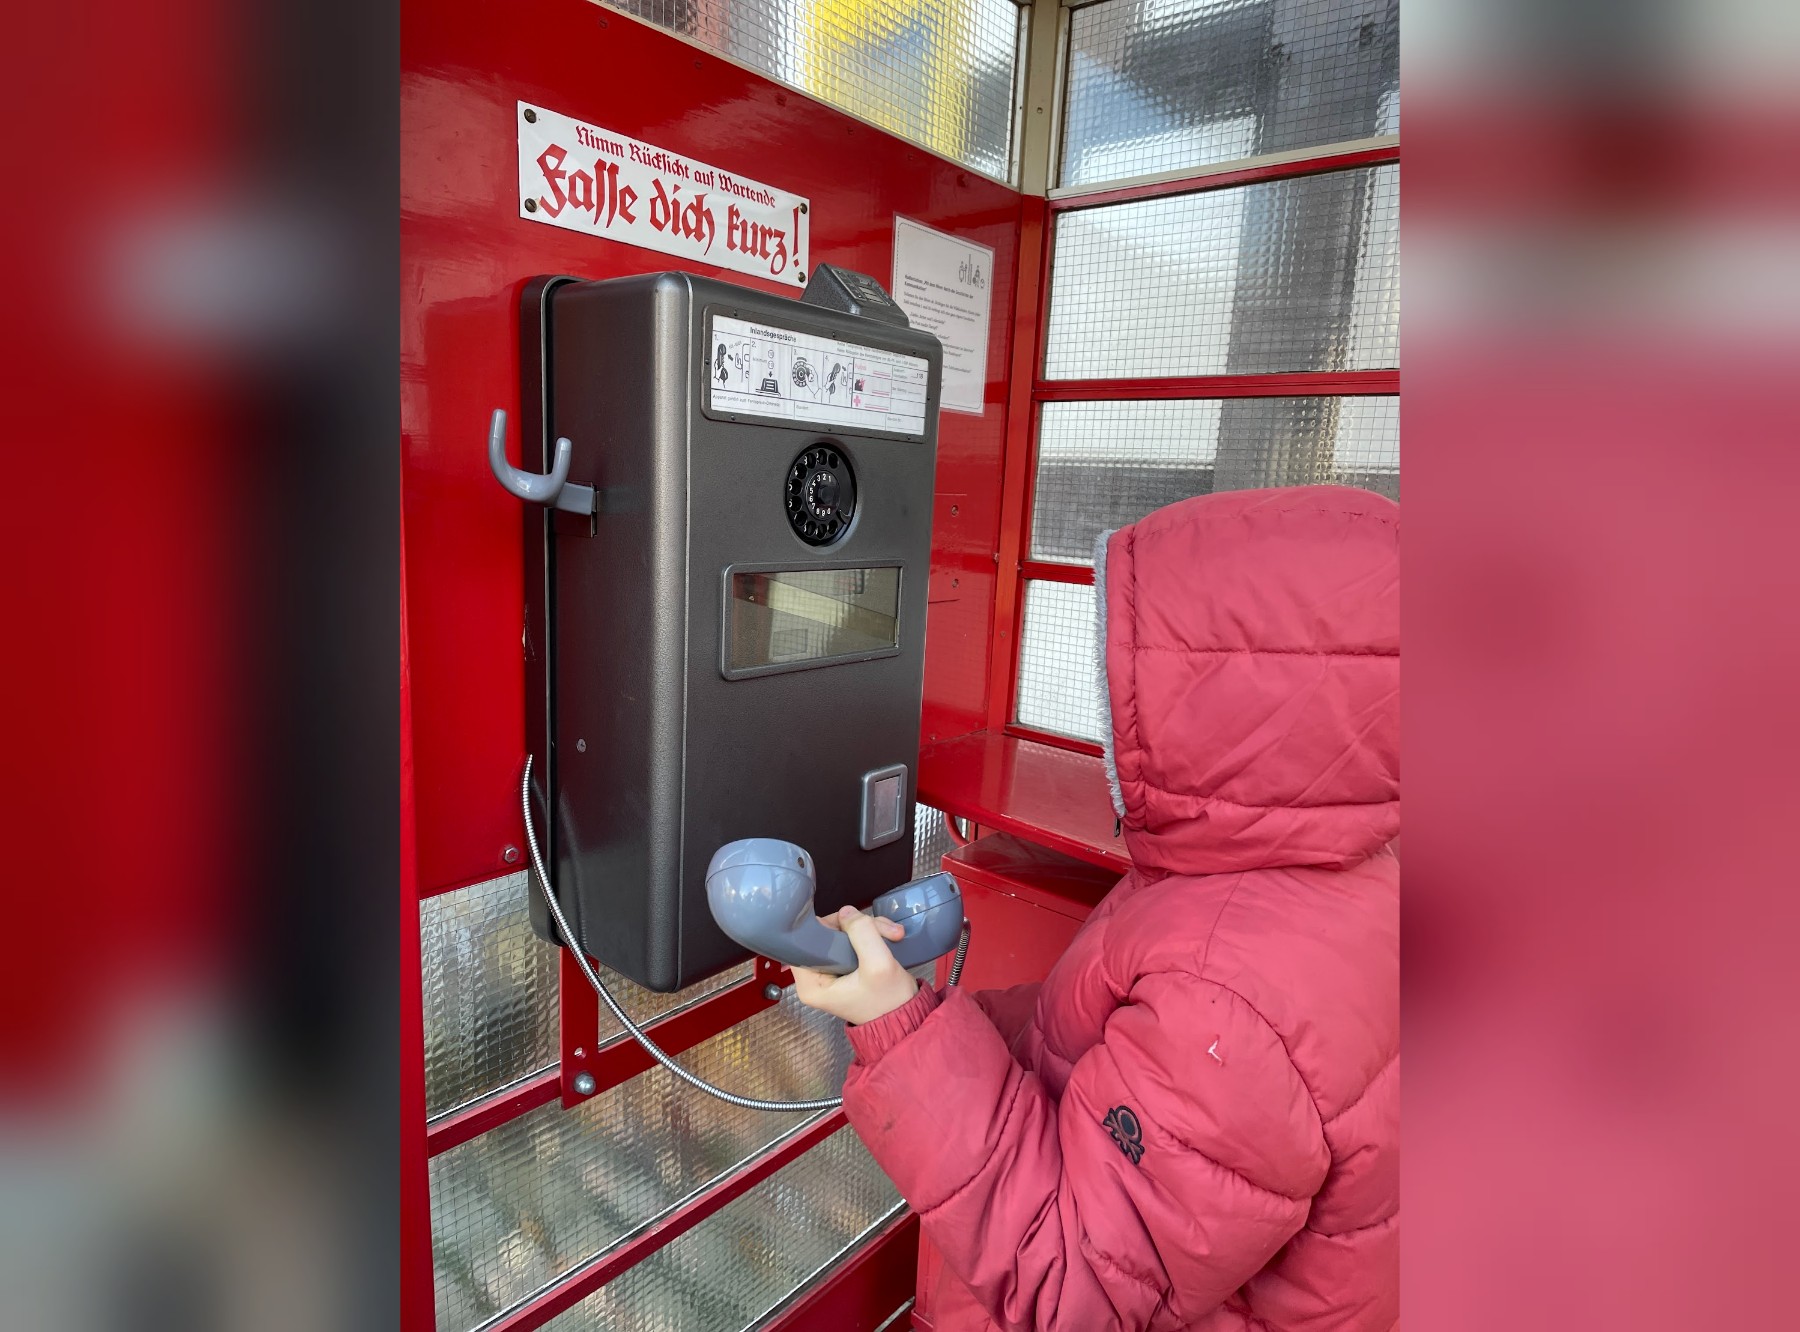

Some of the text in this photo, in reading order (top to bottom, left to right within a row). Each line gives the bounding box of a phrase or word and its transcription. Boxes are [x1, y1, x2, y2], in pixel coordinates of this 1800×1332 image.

[536, 143, 639, 229] Fasse
[649, 178, 716, 256] dich
[576, 125, 776, 209] Nimm Rücksicht auf Wartende
